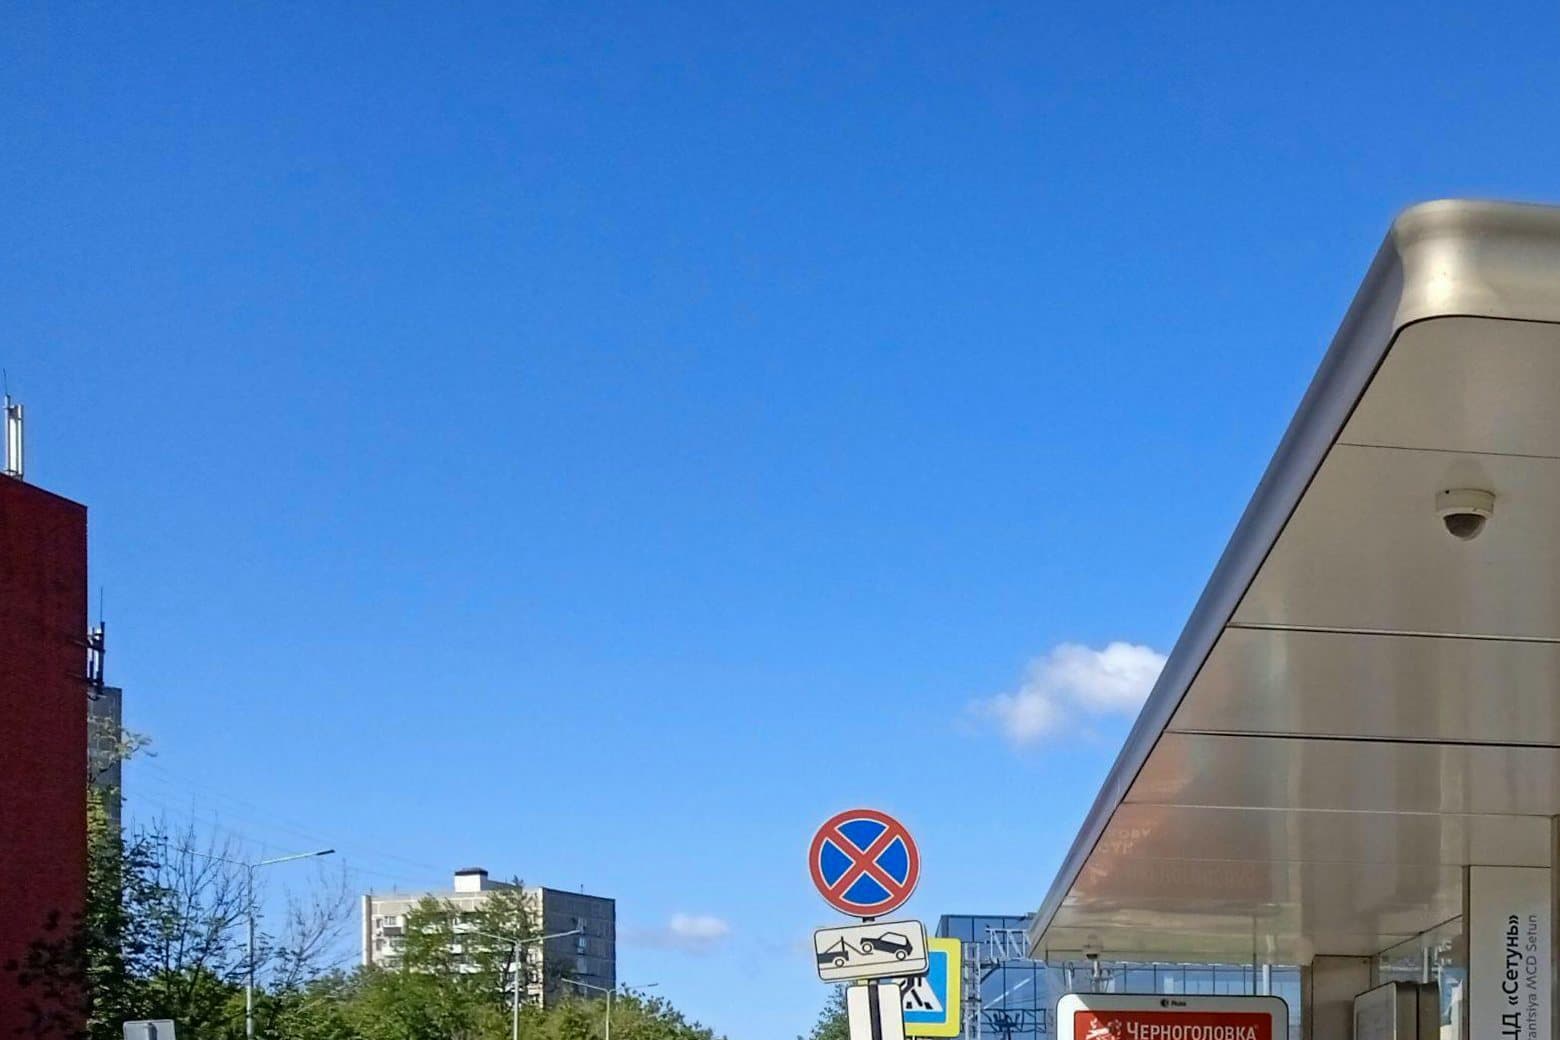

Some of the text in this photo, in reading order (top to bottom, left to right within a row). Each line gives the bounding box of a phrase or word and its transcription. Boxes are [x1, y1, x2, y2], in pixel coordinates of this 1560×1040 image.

[1525, 914, 1537, 952] Setun
[1501, 914, 1523, 1006] «Сетунь»
[1525, 955, 1537, 990] MCD
